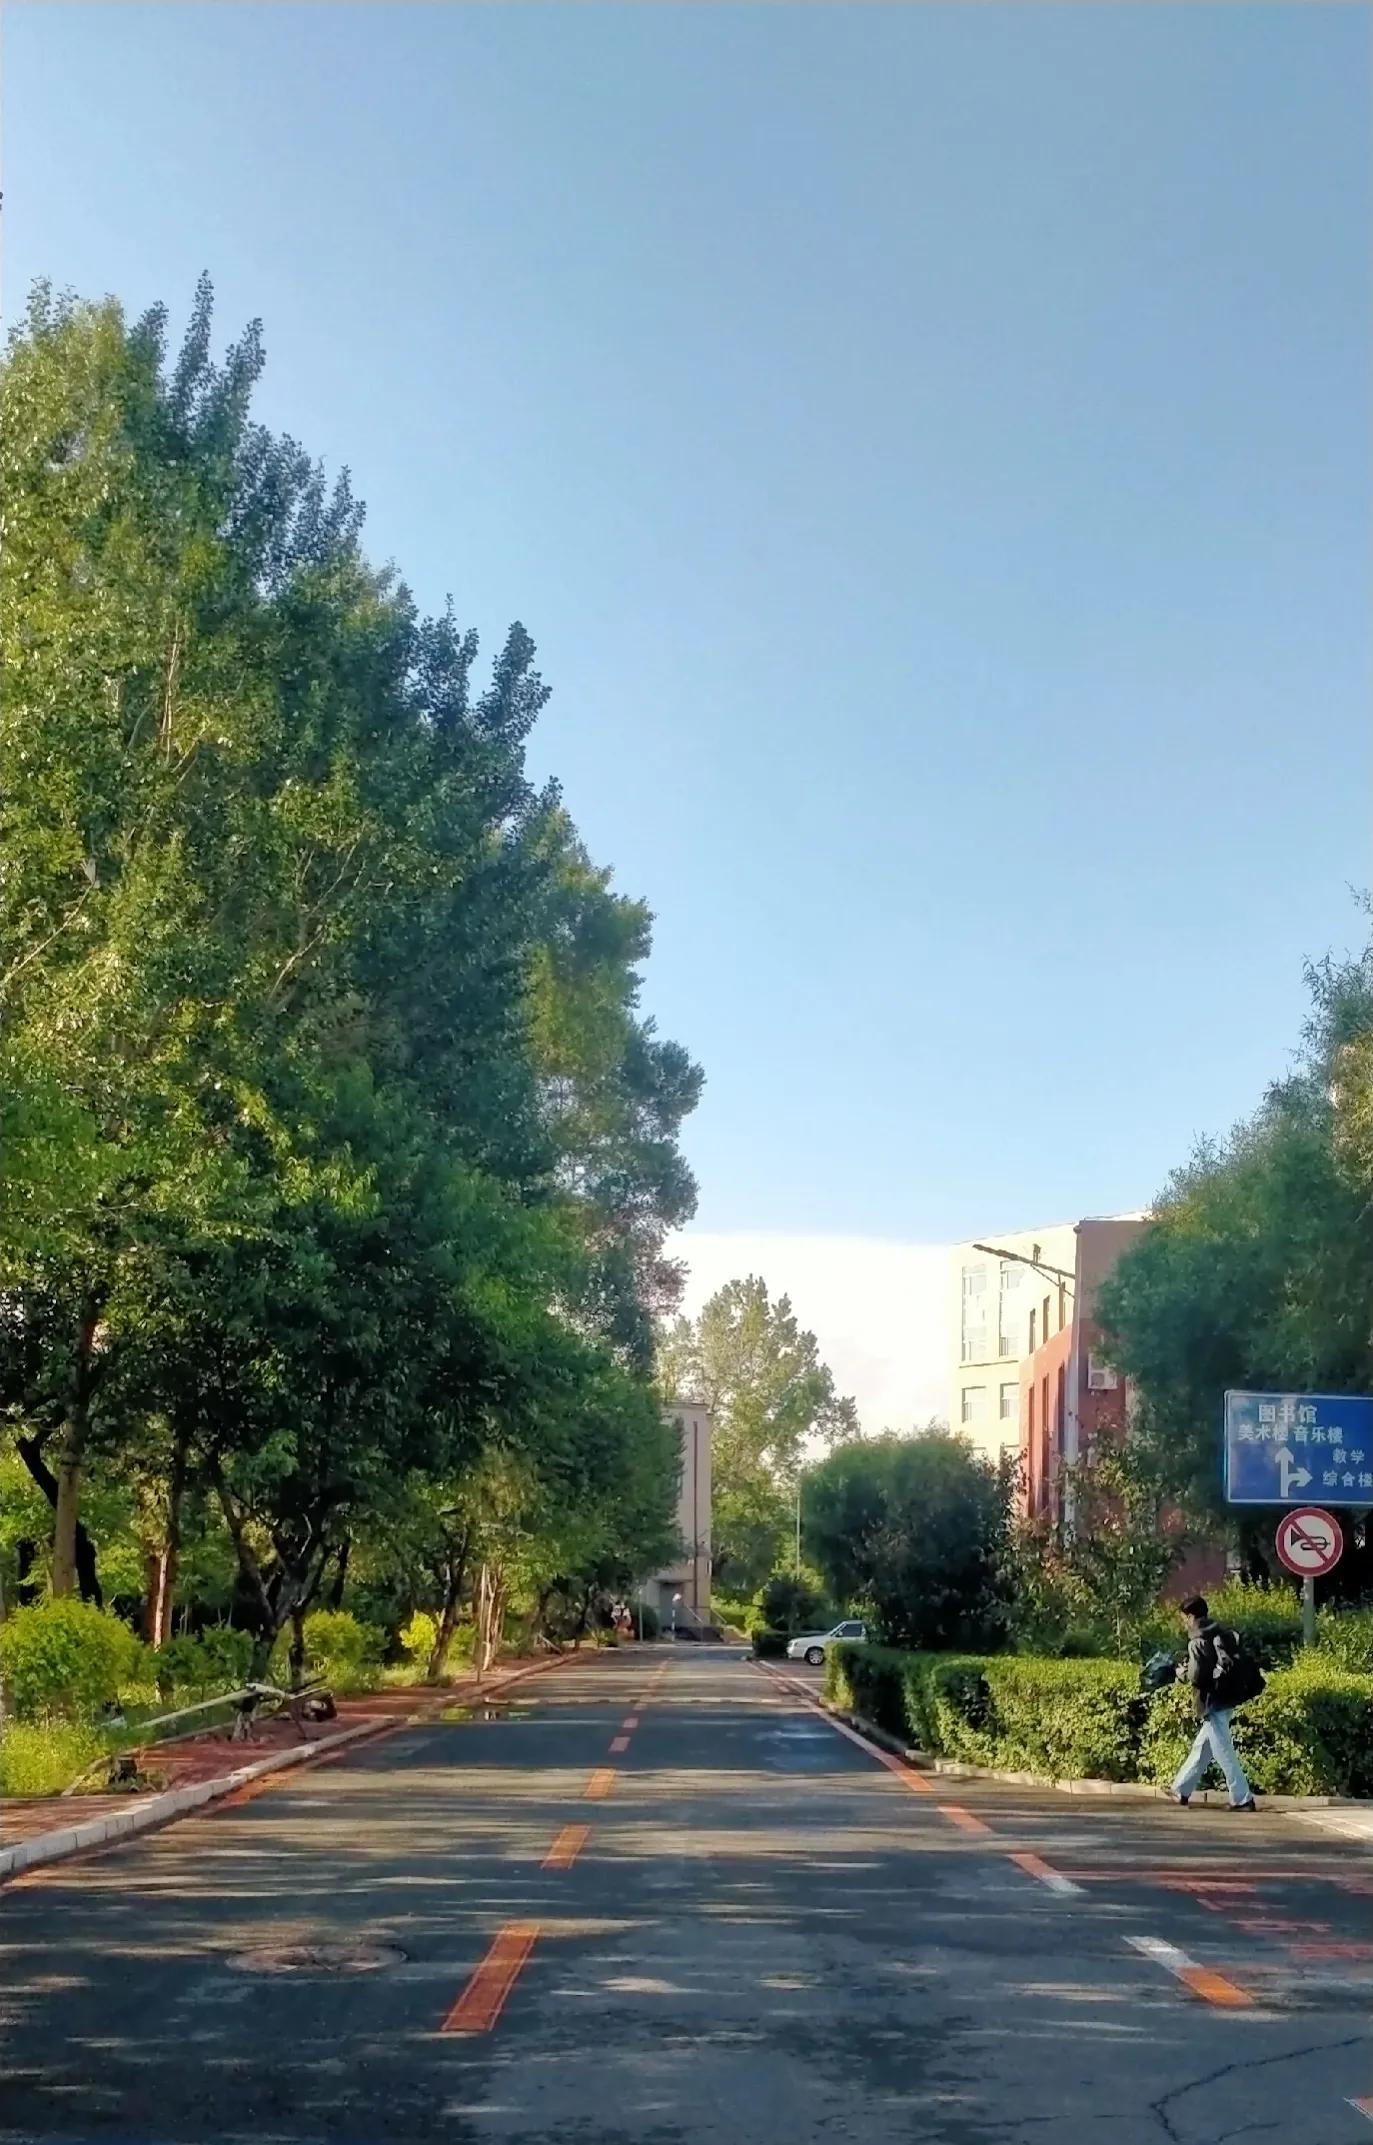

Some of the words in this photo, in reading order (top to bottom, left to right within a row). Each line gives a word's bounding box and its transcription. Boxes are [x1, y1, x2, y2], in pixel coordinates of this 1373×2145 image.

[1258, 1404, 1318, 1424] 图书馆
[1238, 1424, 1289, 1441] 美术楼
[1293, 1425, 1343, 1444] 音乐楼
[1322, 1470, 1373, 1487] 综合楼
